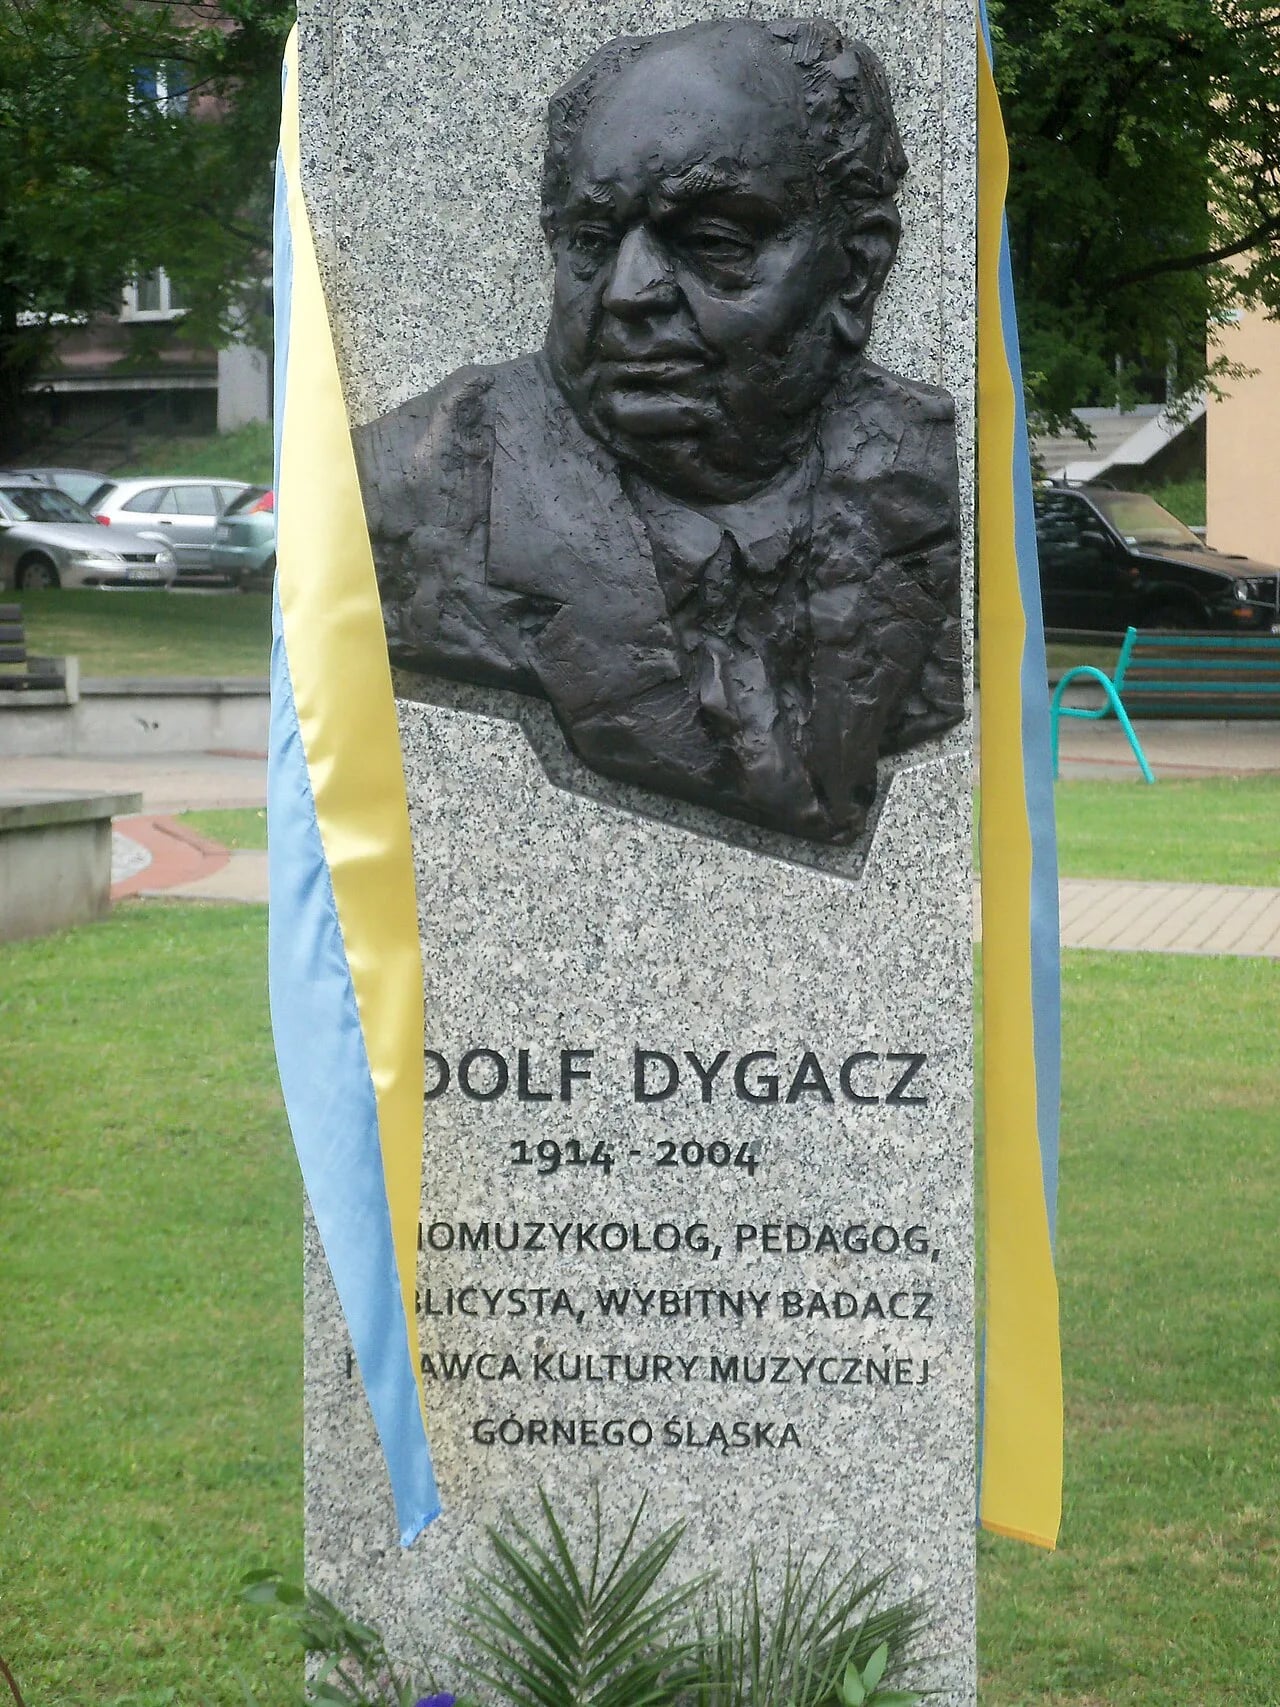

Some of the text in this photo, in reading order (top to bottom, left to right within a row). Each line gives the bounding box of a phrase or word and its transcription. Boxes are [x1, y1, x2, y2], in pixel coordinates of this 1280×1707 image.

[423, 1049, 928, 1104] DOLF DYGACZ
[510, 1140, 615, 1175] 1914
[656, 1140, 759, 1176] 2004
[417, 1222, 940, 1263] OMUZYKOLOG, PEDAGOG,
[415, 1288, 934, 1325] LICYSTA, WYBITNY BADACZ
[420, 1353, 521, 1381] AWCA
[533, 1354, 700, 1382] KULTURY
[710, 1355, 930, 1385] MUZYCZNEJ
[473, 1412, 801, 1454] GÓRNEGO ŚLĄSKA
